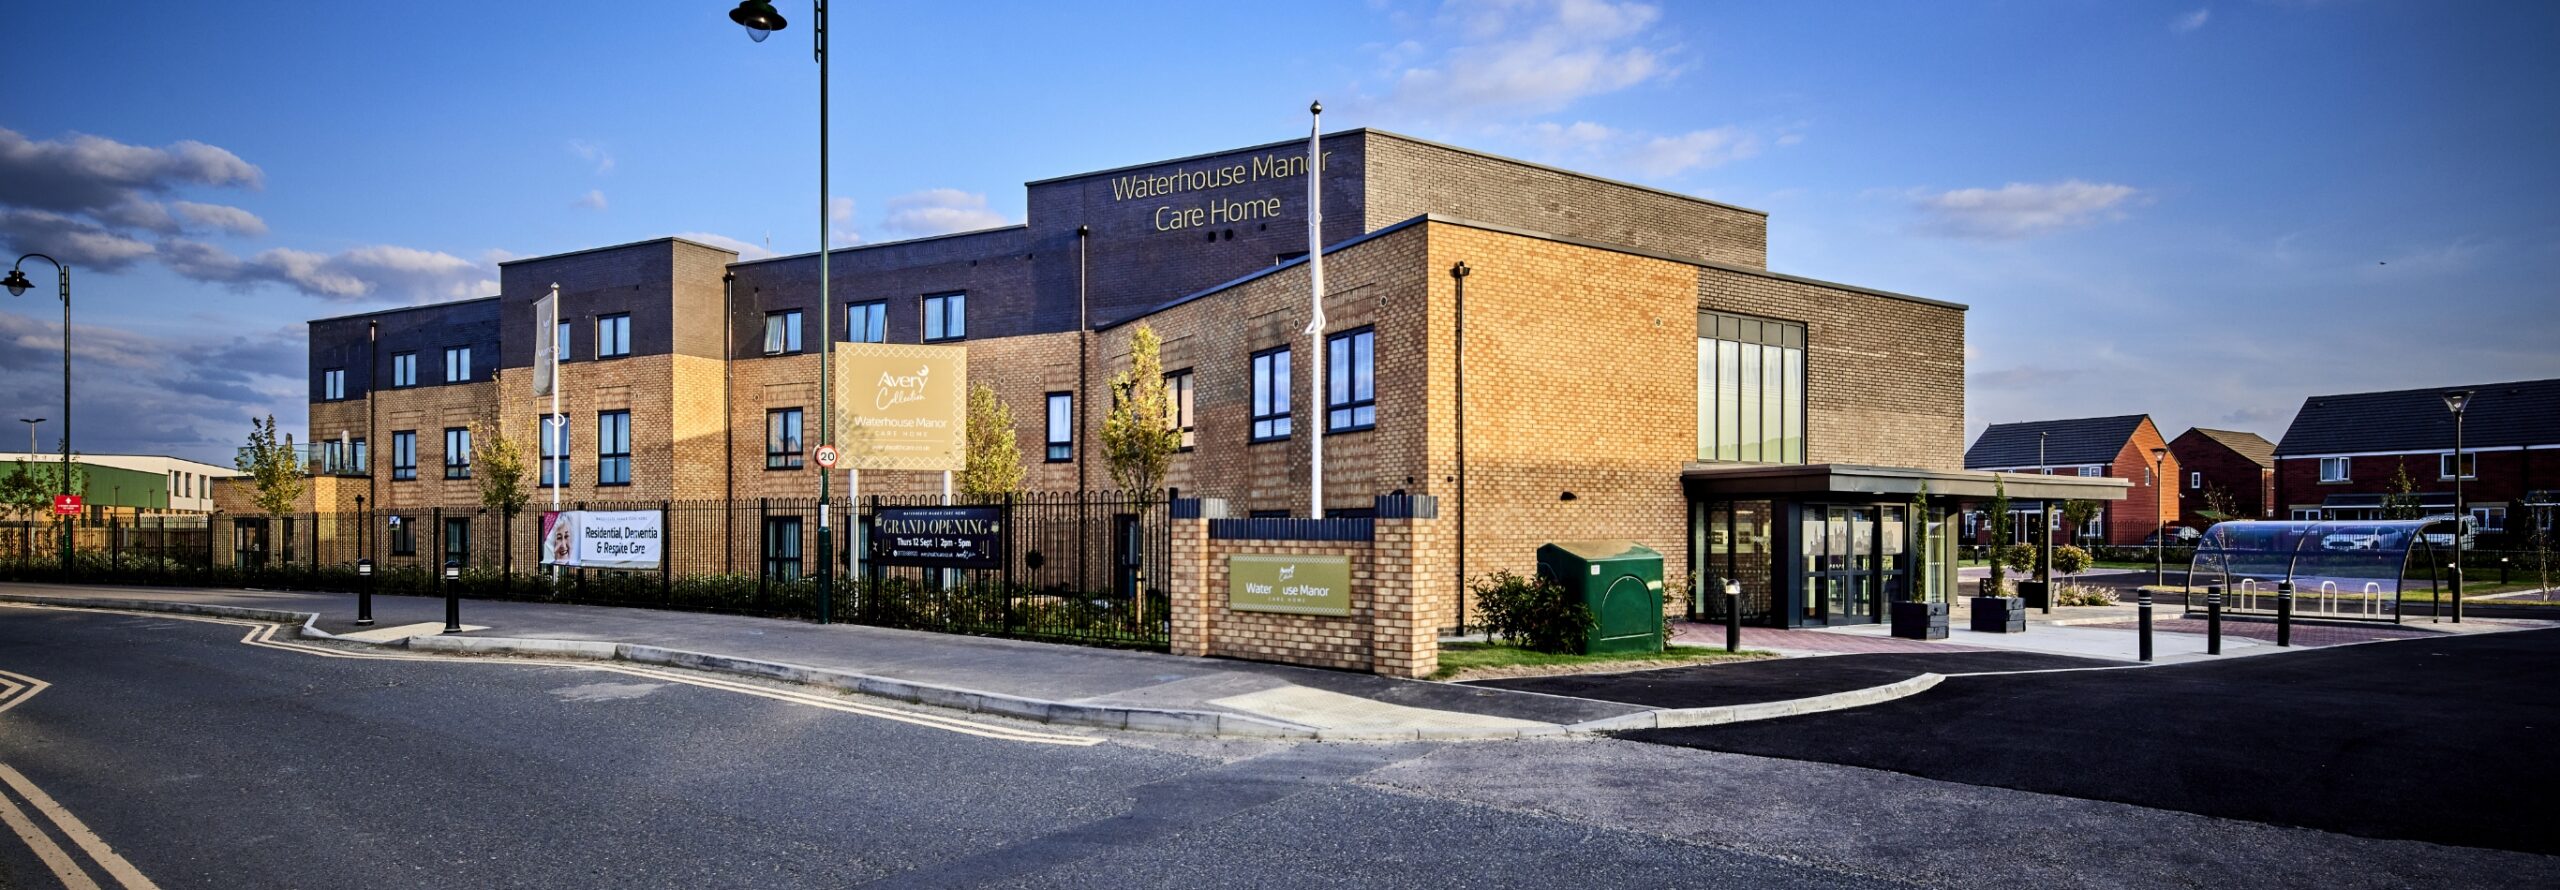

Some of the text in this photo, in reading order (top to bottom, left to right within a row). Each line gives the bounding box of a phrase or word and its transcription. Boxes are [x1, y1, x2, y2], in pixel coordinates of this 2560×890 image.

[1112, 165, 1246, 202] Waterhouse
[1155, 197, 1281, 232] Care Home
[877, 371, 928, 393] Avery
[876, 387, 926, 410] Collection
[854, 416, 948, 429] Waterhouse Manor
[874, 430, 897, 438] CARE
[820, 451, 835, 462] 20
[585, 526, 658, 540] Residential, Dementia
[883, 519, 988, 535] GRAND OPENING
[596, 542, 645, 556] & Respite Care
[897, 537, 912, 547] Thurs
[913, 538, 919, 547] 12
[920, 537, 933, 549] Sept
[940, 538, 954, 549] 2pm
[958, 538, 972, 549] 5pm
[1299, 585, 1330, 597] Manor
